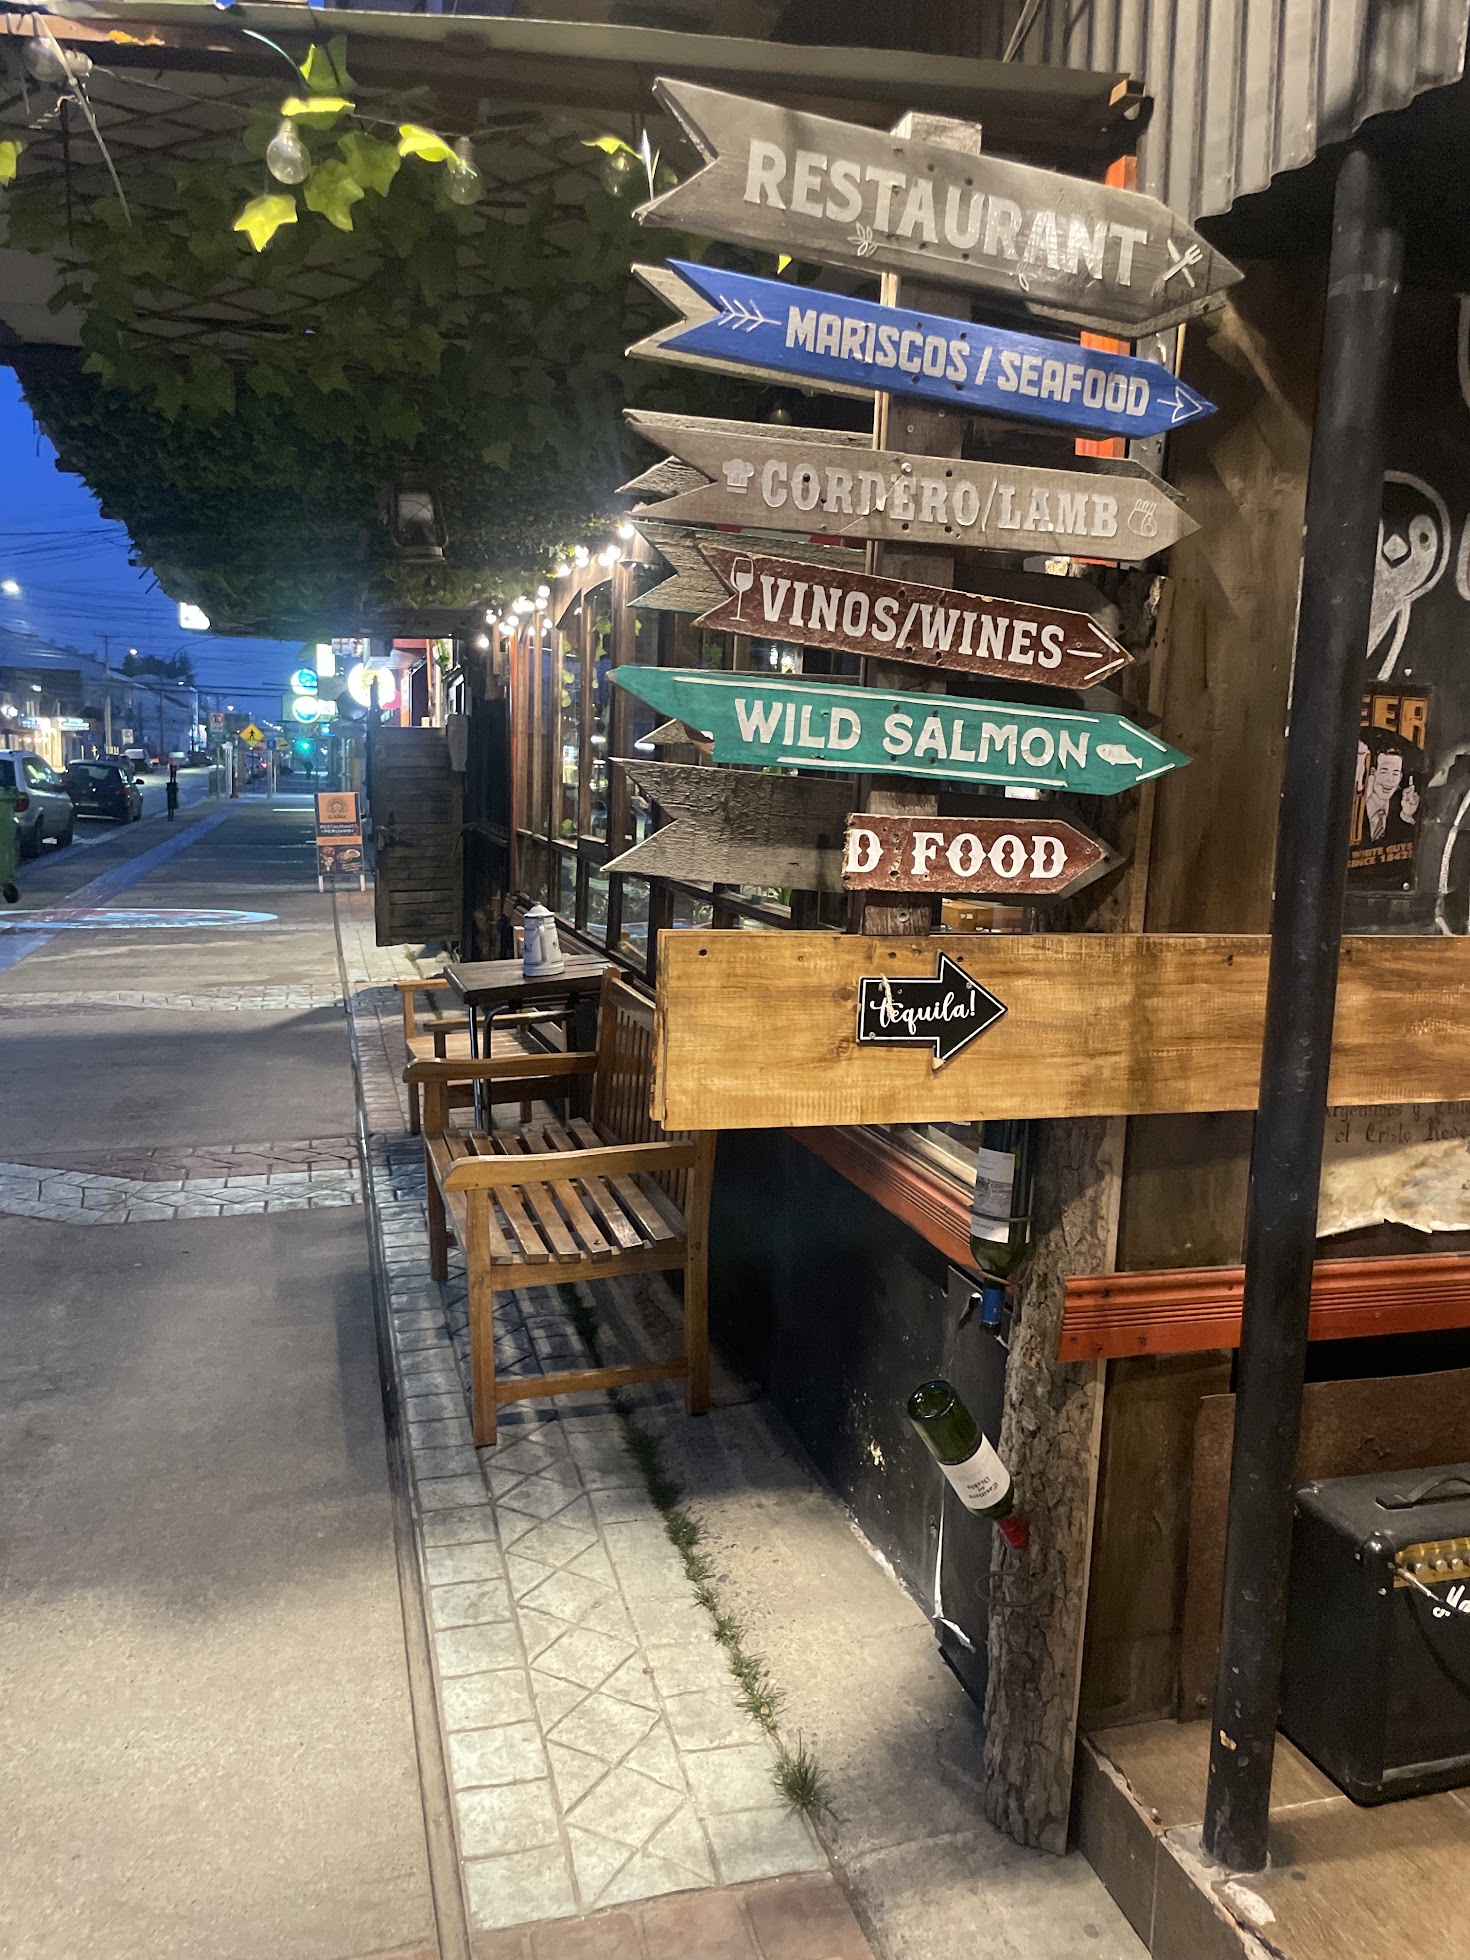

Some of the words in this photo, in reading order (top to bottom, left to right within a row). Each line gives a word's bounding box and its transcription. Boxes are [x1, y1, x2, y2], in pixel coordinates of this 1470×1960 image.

[743, 137, 1149, 287] RESTAURANT
[784, 305, 971, 383] MARISCOS
[996, 350, 1151, 417] SEAFOOD
[760, 459, 1119, 538] CORDERO/LAMB
[759, 574, 1066, 669] VINOS/WINES
[734, 698, 862, 752] WILD
[882, 713, 1092, 770] SALMON
[845, 828, 884, 873] D
[911, 832, 1069, 879] FOOD
